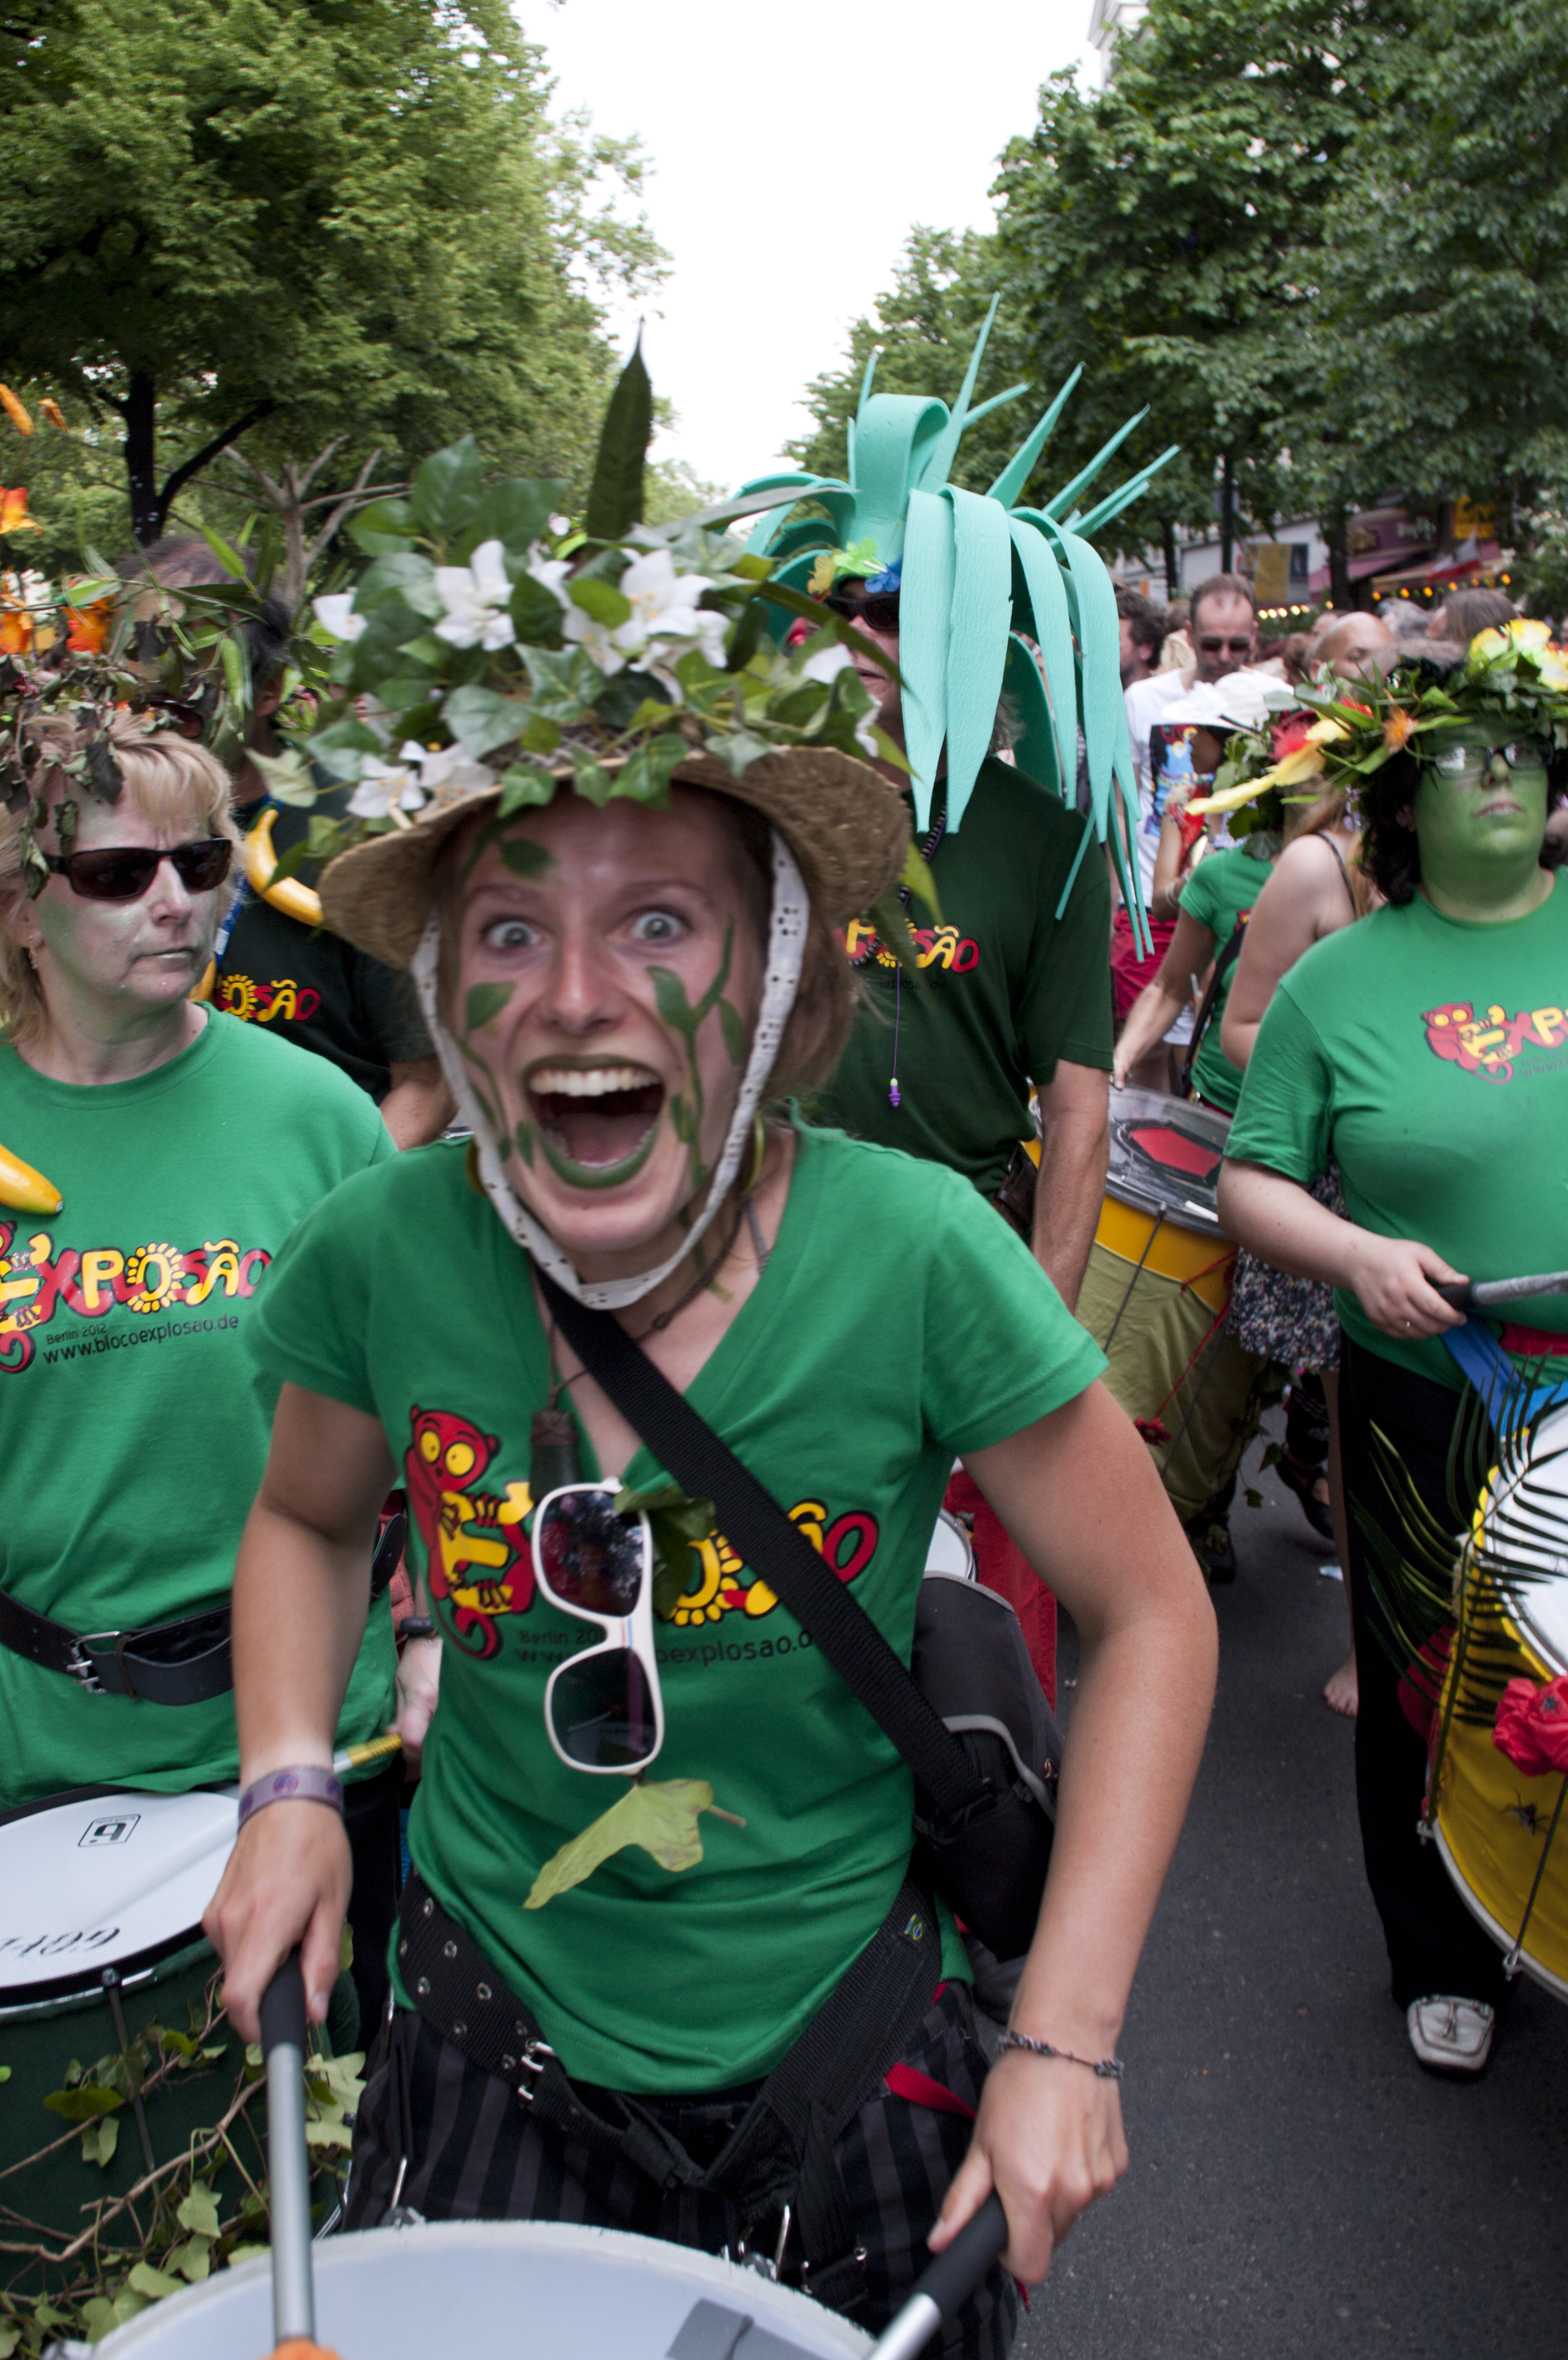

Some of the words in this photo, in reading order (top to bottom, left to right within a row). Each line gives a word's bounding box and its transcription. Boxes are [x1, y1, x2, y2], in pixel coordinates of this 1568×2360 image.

[42, 1314, 239, 1364] www.blocoexplosao.de
[46, 1328, 79, 1345] Berlin
[82, 1322, 108, 1338] 2012
